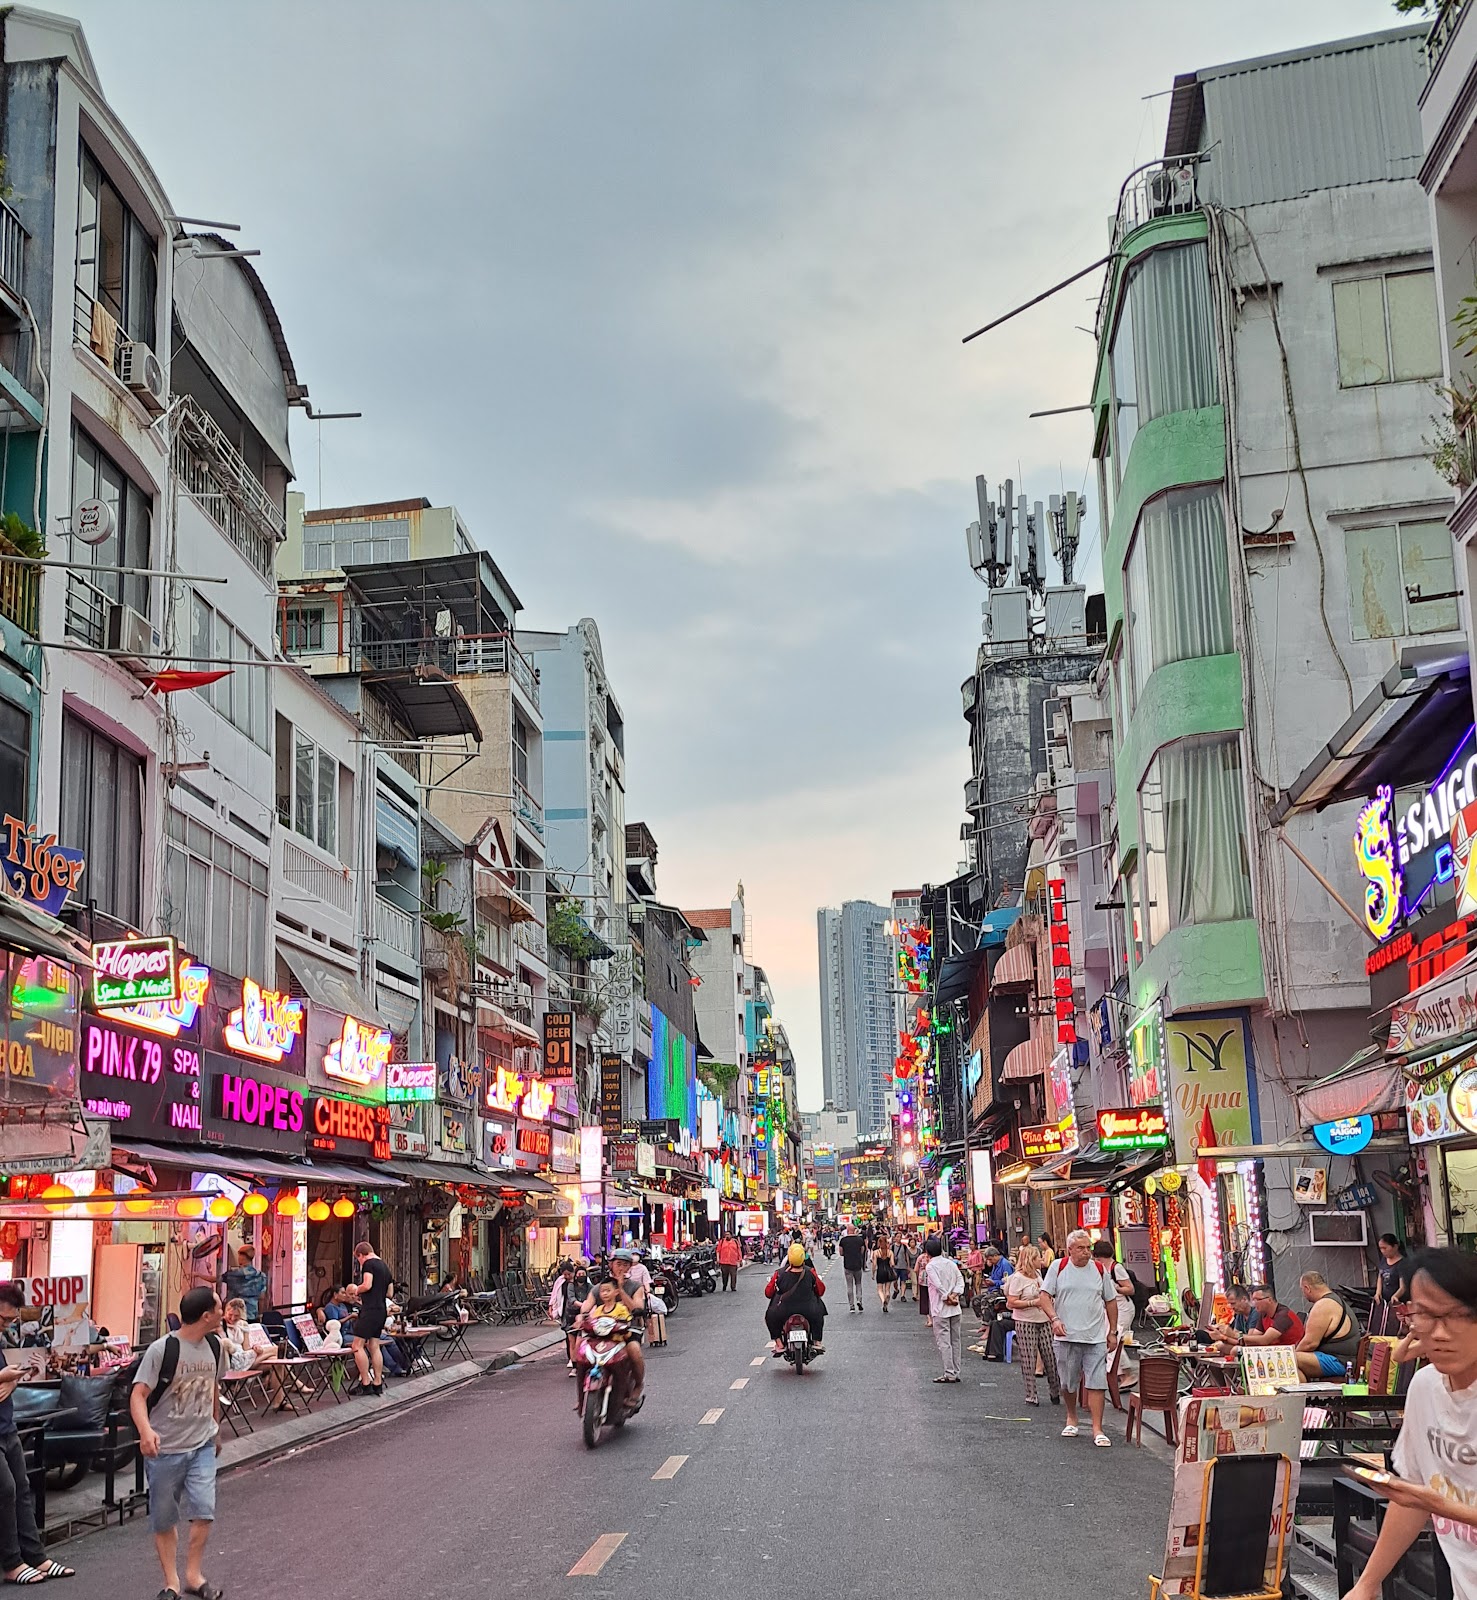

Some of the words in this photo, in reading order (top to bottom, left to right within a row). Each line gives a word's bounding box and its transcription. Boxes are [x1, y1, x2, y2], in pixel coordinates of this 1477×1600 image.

[1397, 815, 1410, 866] BIA
[3, 813, 84, 901] Tiger
[95, 944, 171, 980] Hopes
[261, 990, 303, 1045] Tiger
[546, 1014, 571, 1026] COLD
[1053, 977, 1078, 1043] SPA
[546, 1027, 571, 1039] BEER
[87, 1025, 139, 1081] PINK
[141, 1039, 162, 1085] 79
[357, 1024, 394, 1072] Tiger
[546, 1040, 570, 1064] 91
[1172, 1029, 1236, 1072] NY
[173, 1047, 200, 1077] SPA
[389, 1064, 435, 1088] Cheers
[191, 1081, 200, 1099] &
[221, 1073, 304, 1133] HOPES
[605, 1093, 618, 1101] 97
[1175, 1082, 1243, 1118] Yuna
[87, 1099, 97, 1113] 79
[171, 1102, 202, 1129] NAIL
[315, 1096, 376, 1143] CHEERS
[377, 1106, 391, 1125] SPA
[1100, 1113, 1138, 1138] Yuna
[1138, 1111, 1166, 1135] Spa
[1329, 1126, 1362, 1137] SAIGON
[374, 1140, 392, 1160] NAIL
[395, 1132, 409, 1151] 85
[493, 1134, 508, 1154] 89
[32, 1277, 84, 1307] SHOP
